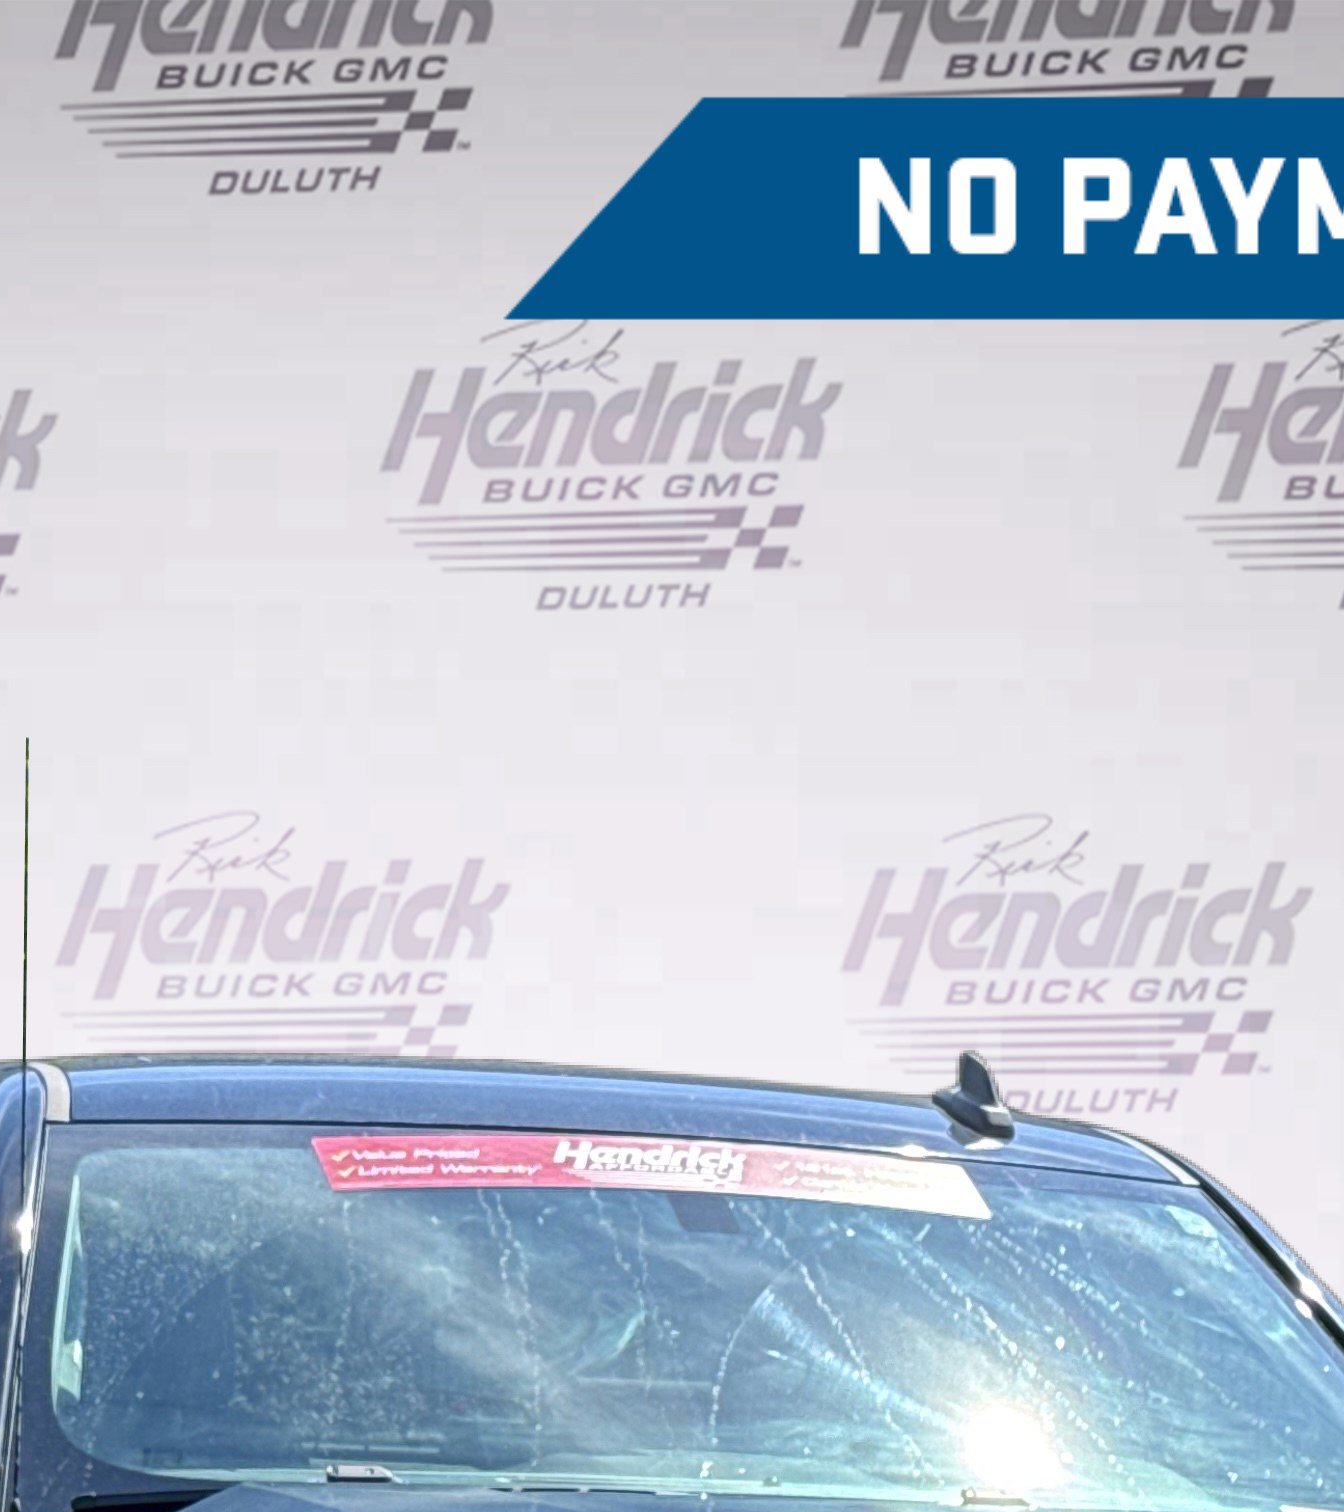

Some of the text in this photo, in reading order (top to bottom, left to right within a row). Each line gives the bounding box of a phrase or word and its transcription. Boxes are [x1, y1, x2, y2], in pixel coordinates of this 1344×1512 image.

[156, 55, 448, 89] BUICK GMC
[945, 44, 1248, 79] BUICK GMC
[207, 167, 381, 196] DULUTH
[379, 357, 843, 506] Hendrick
[482, 471, 779, 503] BUICK GMC
[535, 583, 711, 611] DULUTH
[54, 856, 511, 1000] Hendrick
[839, 859, 1313, 1006] Hendrick
[156, 969, 448, 998] BUICK GMC
[945, 974, 1248, 1004] BUICK GMC
